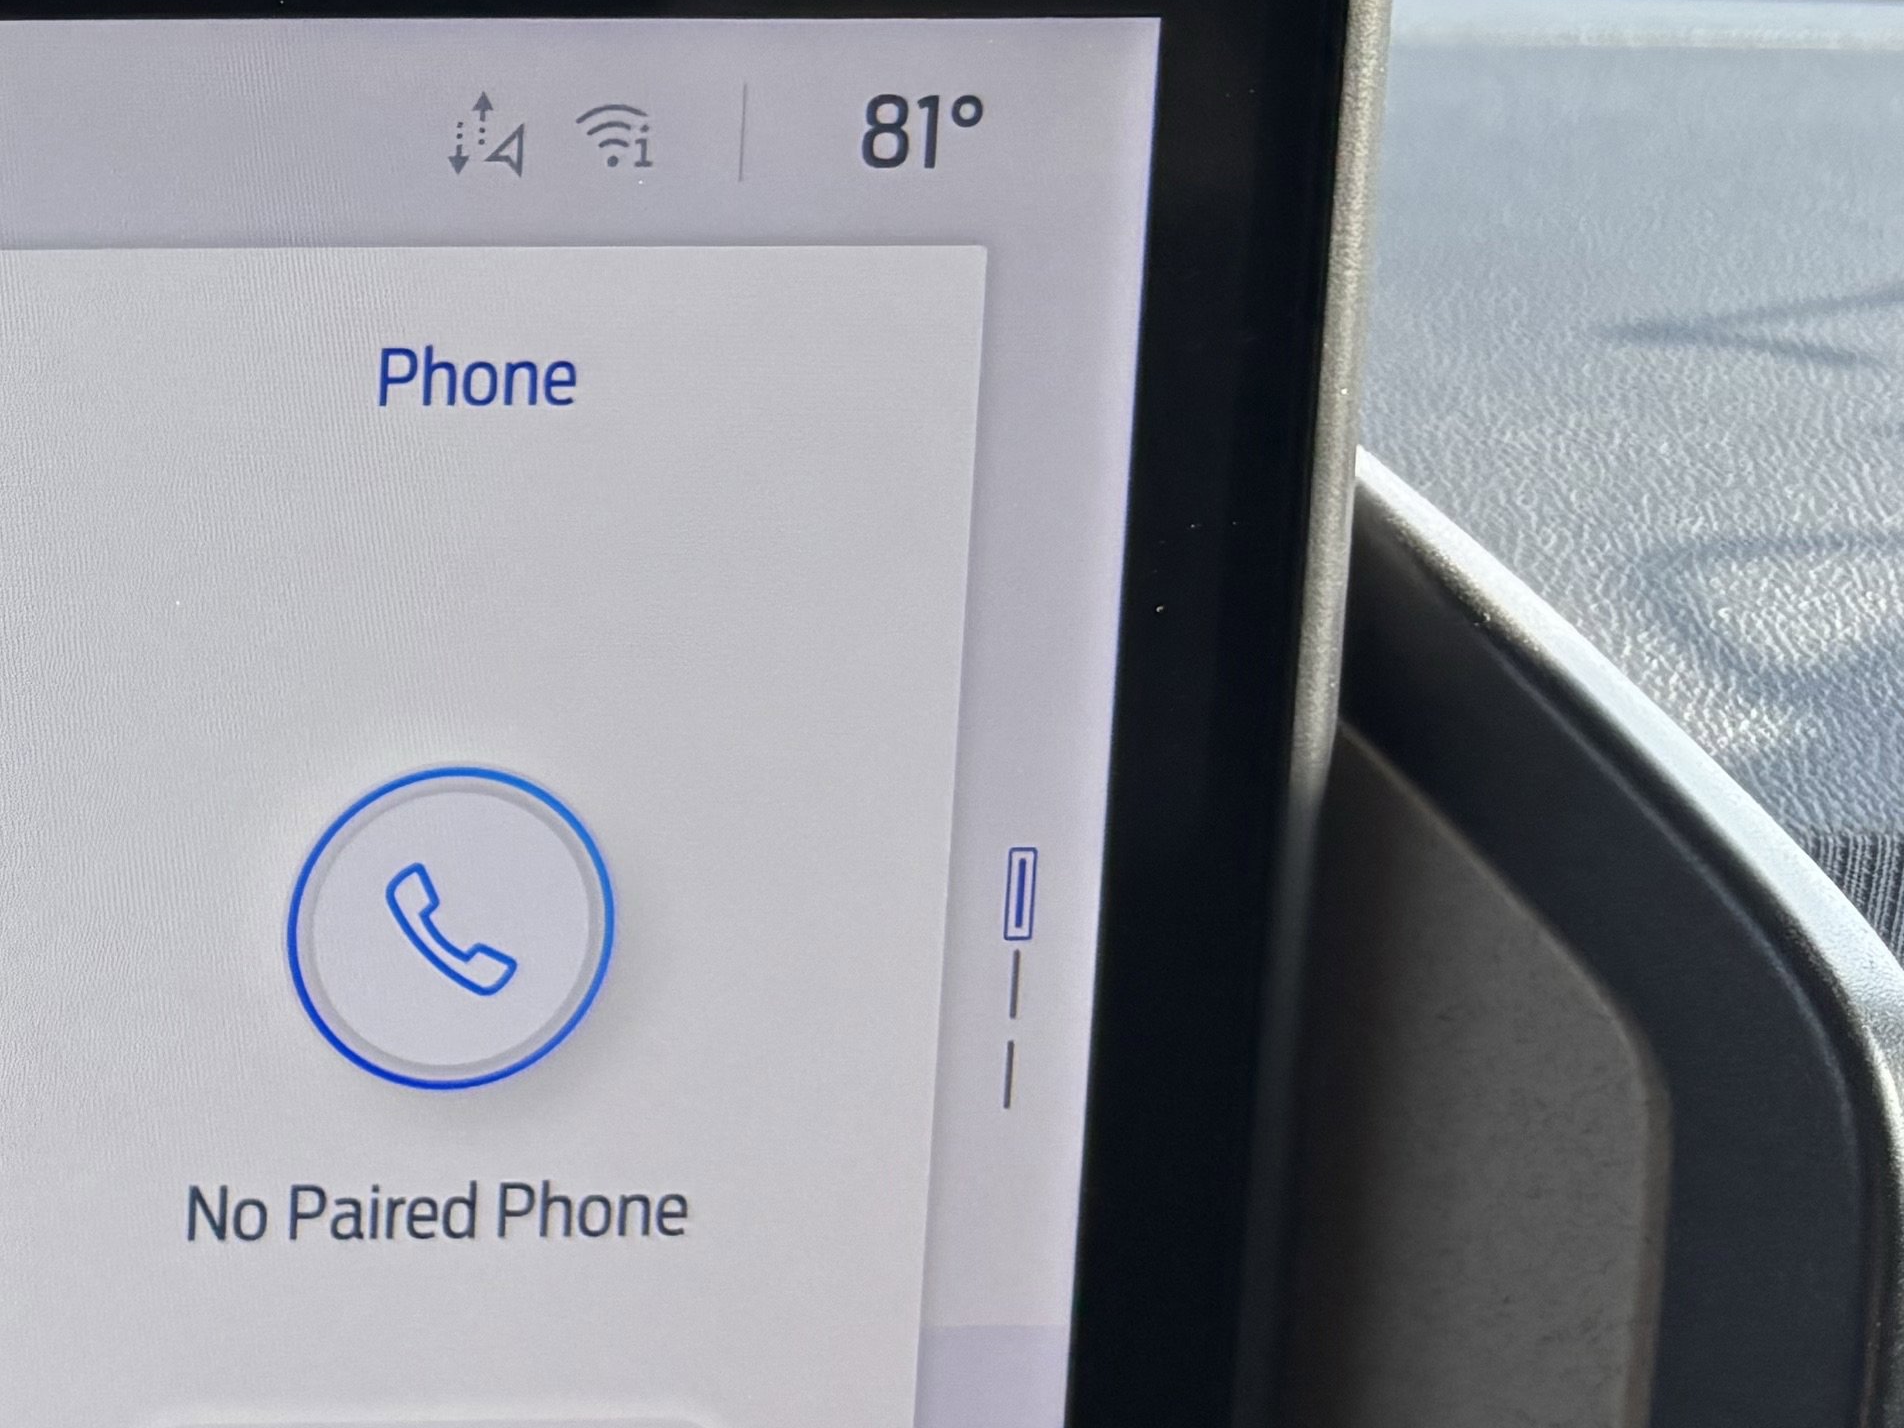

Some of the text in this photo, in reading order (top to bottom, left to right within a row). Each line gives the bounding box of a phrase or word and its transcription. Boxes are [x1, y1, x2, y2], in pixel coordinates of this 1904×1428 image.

[861, 93, 985, 169] 81°
[378, 344, 577, 407] Phone
[187, 1179, 689, 1243] No Paired Phone
